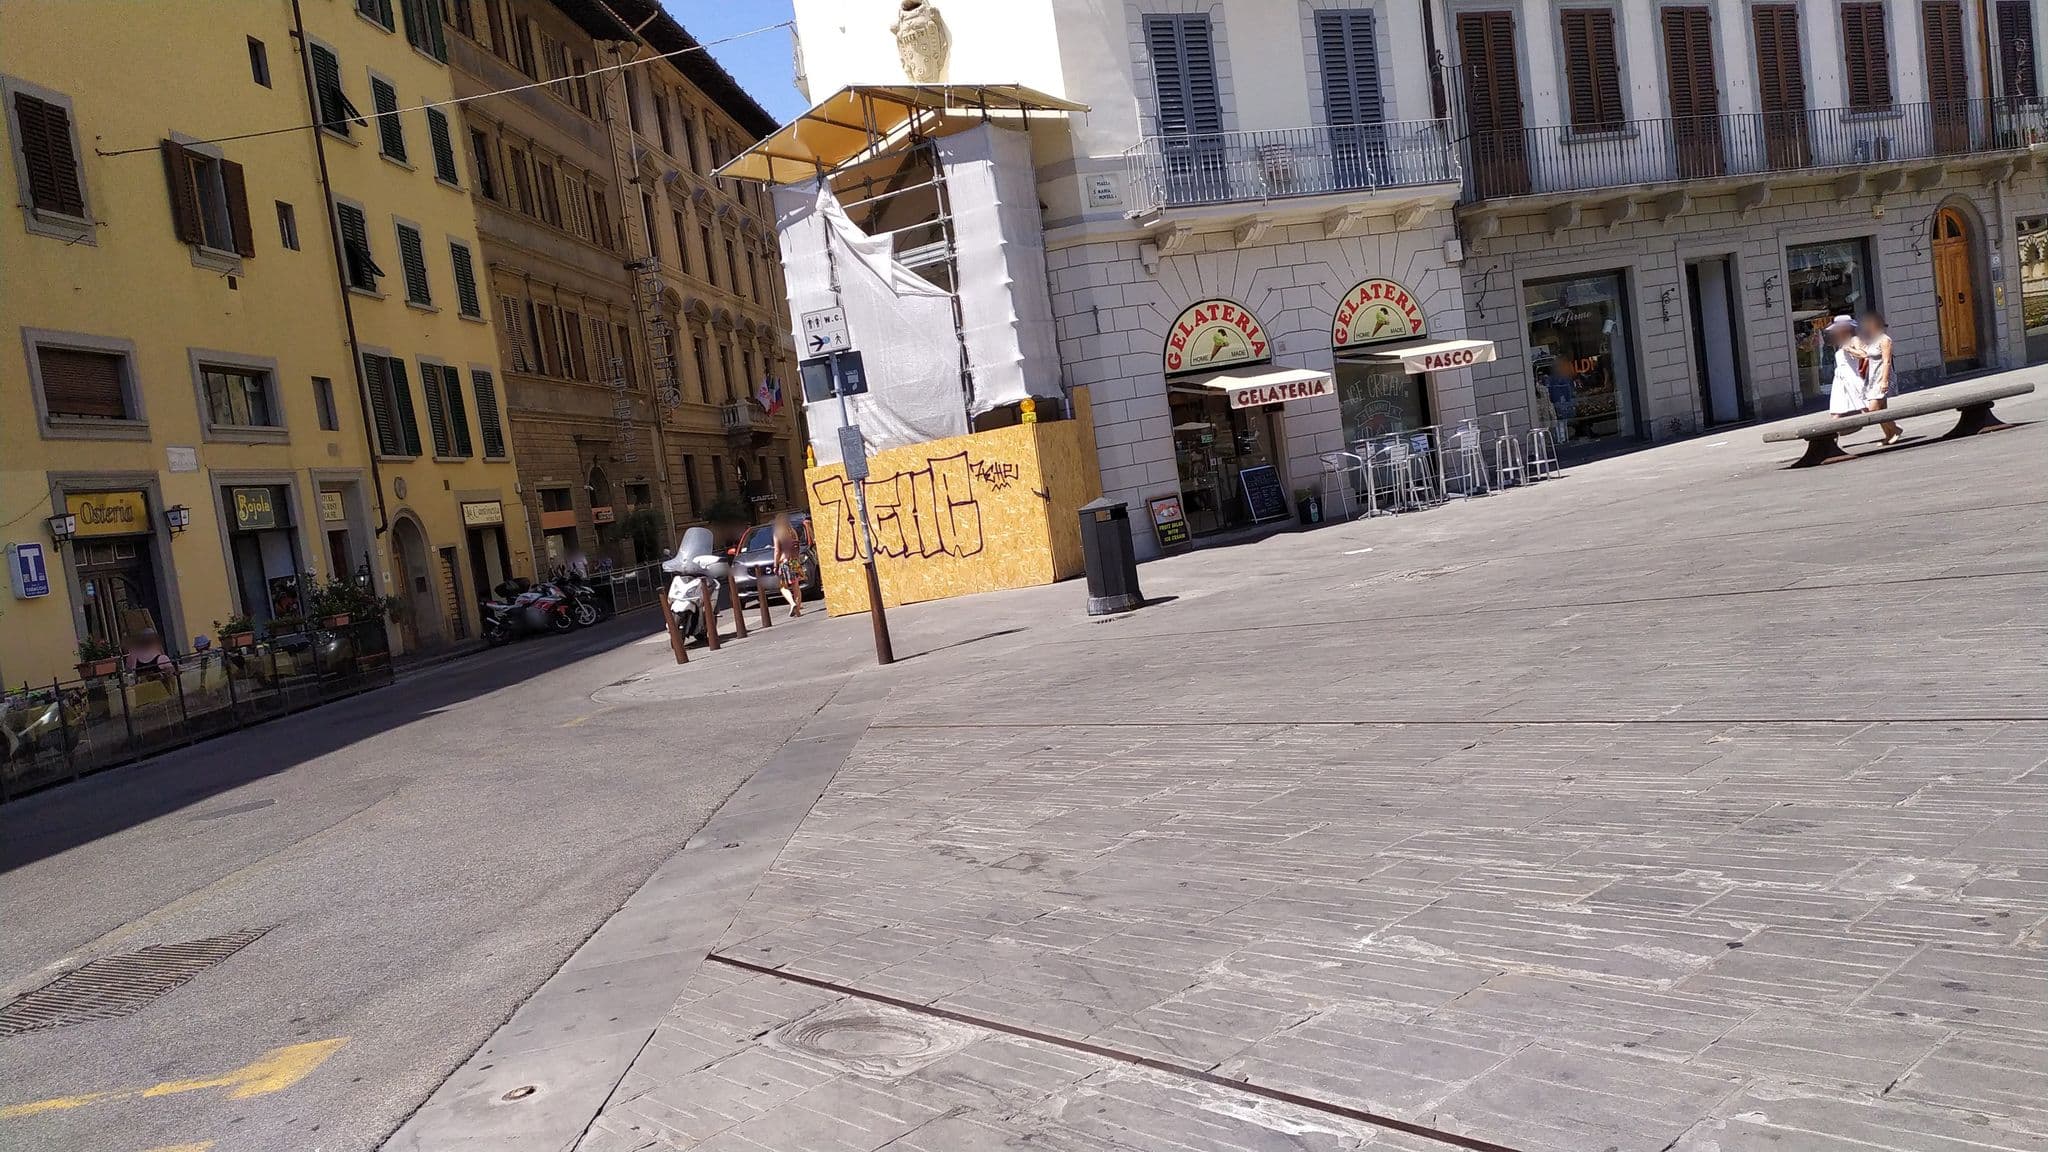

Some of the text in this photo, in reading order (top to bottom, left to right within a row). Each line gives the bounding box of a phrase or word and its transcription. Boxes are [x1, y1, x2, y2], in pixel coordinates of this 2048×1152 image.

[824, 314, 843, 325] W.C.
[1335, 283, 1423, 345] GELATERIA
[1167, 304, 1266, 370] GELATERIA
[1193, 350, 1246, 363] HOME MADE
[1425, 350, 1474, 370] PASCO
[1238, 380, 1325, 406] GELATERIA
[80, 499, 134, 525] Osteria
[237, 495, 271, 521] Bojola
[20, 548, 40, 581] T
